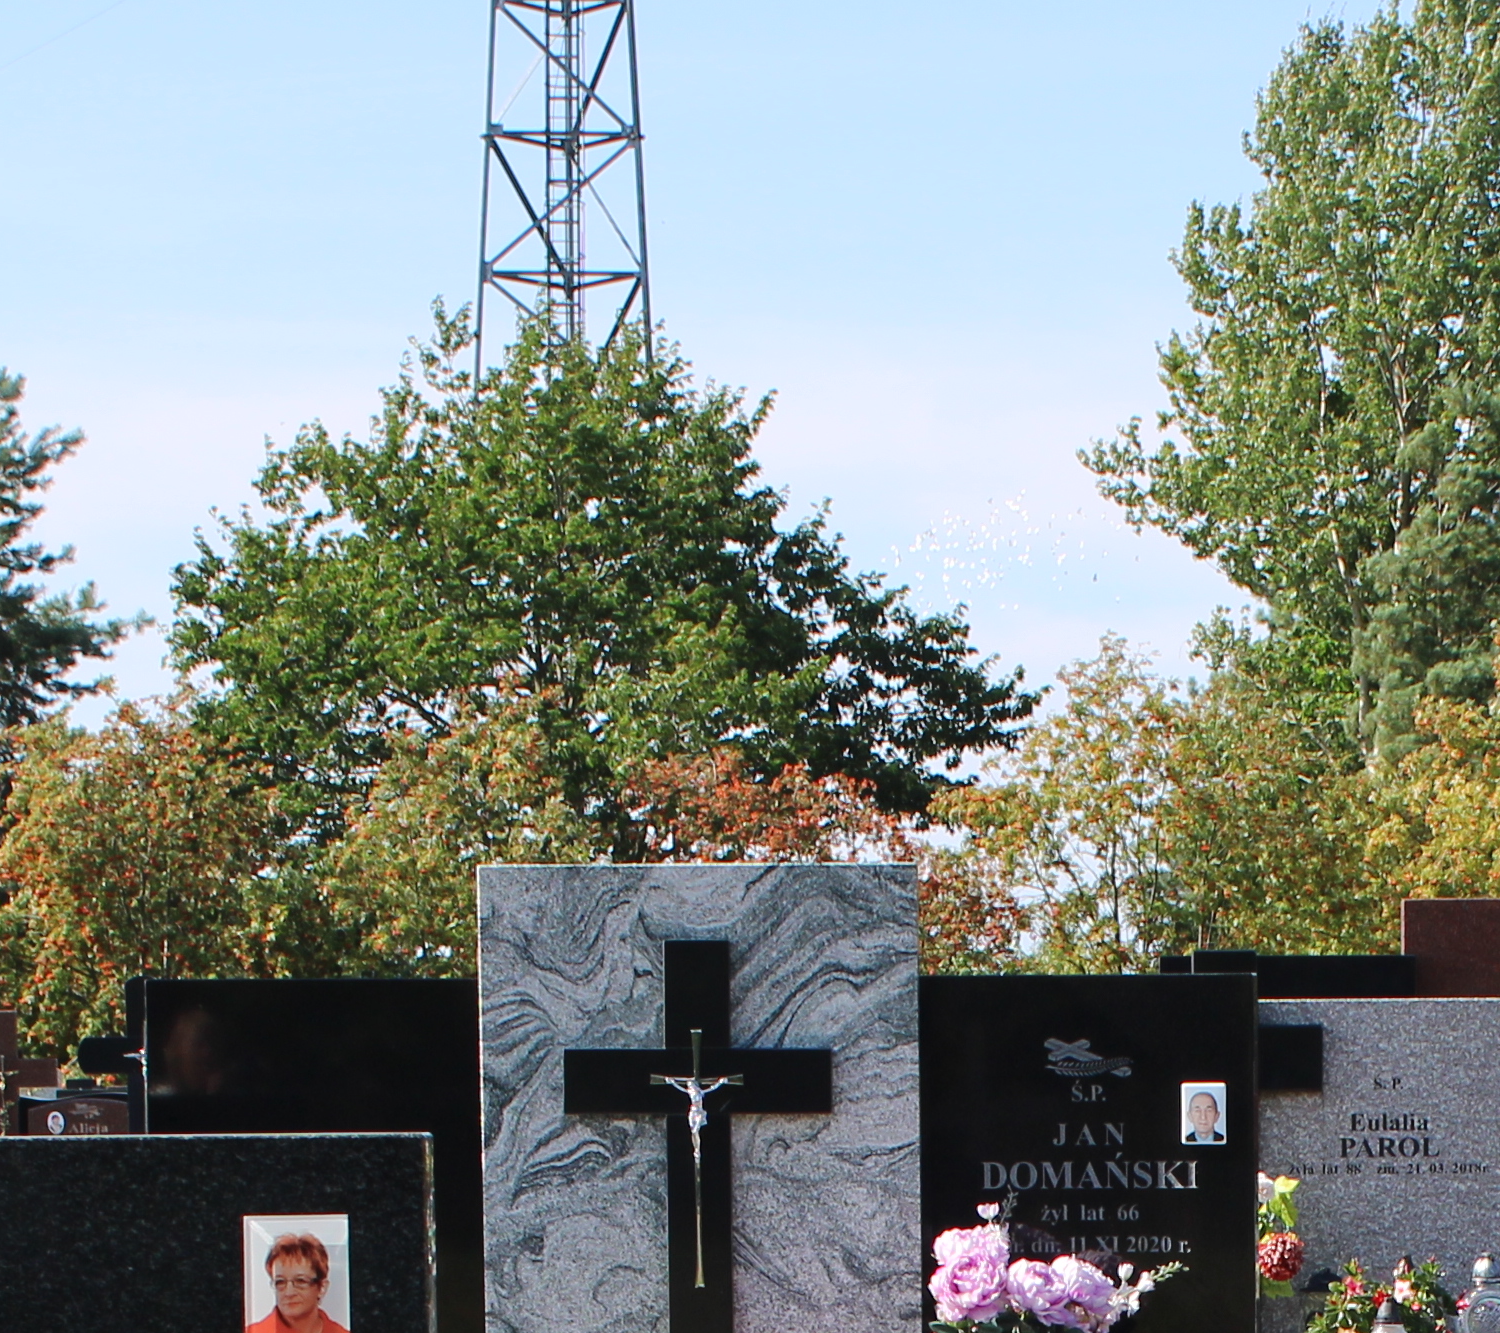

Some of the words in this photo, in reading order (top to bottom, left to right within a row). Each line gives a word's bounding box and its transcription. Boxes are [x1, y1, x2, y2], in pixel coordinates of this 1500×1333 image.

[1351, 1113, 1428, 1131] Eulalia
[1340, 1138, 1440, 1158] PAROL
[982, 1152, 1199, 1190] DOMAŃSKI
[1080, 1204, 1104, 1221] lat
[1117, 1204, 1139, 1221] 66
[1031, 1236, 1061, 1253] dn.
[1096, 1236, 1118, 1252] XI
[1126, 1236, 1171, 1253] 2020
